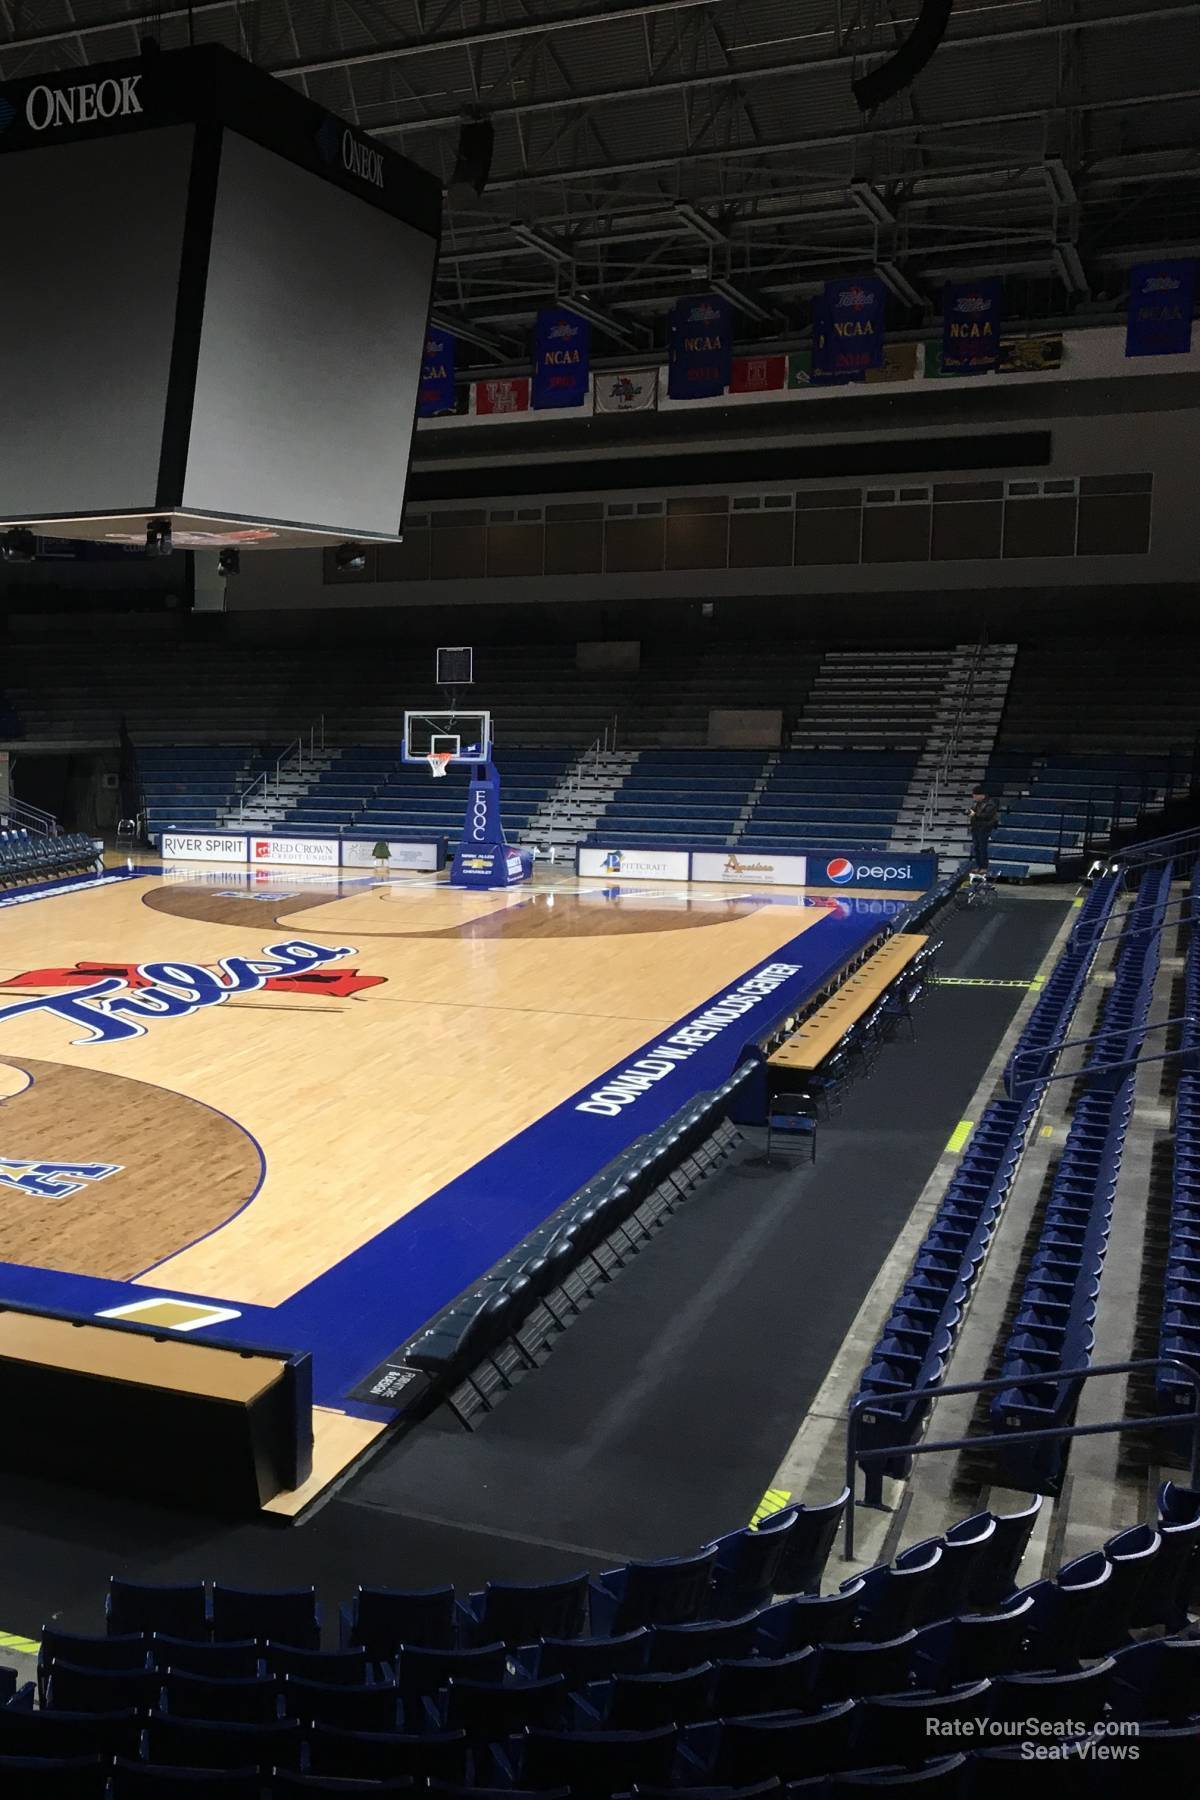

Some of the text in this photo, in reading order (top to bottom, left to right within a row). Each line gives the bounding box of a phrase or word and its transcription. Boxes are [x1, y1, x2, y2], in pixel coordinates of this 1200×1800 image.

[25, 74, 143, 131] ONEOK
[342, 128, 384, 188] ONEOK
[833, 320, 875, 337] NCAA
[950, 321, 992, 338] NCAA
[684, 335, 721, 352] NCAA
[544, 349, 581, 366] NCAA
[422, 364, 447, 381] CAA
[164, 837, 243, 855] RIVER SPIRIT
[271, 841, 334, 855] RED CROWN
[856, 865, 912, 881] pepsi
[575, 1059, 676, 1117] DONALD
[667, 994, 757, 1048] REYNOLDS
[736, 963, 803, 1001] CENTER
